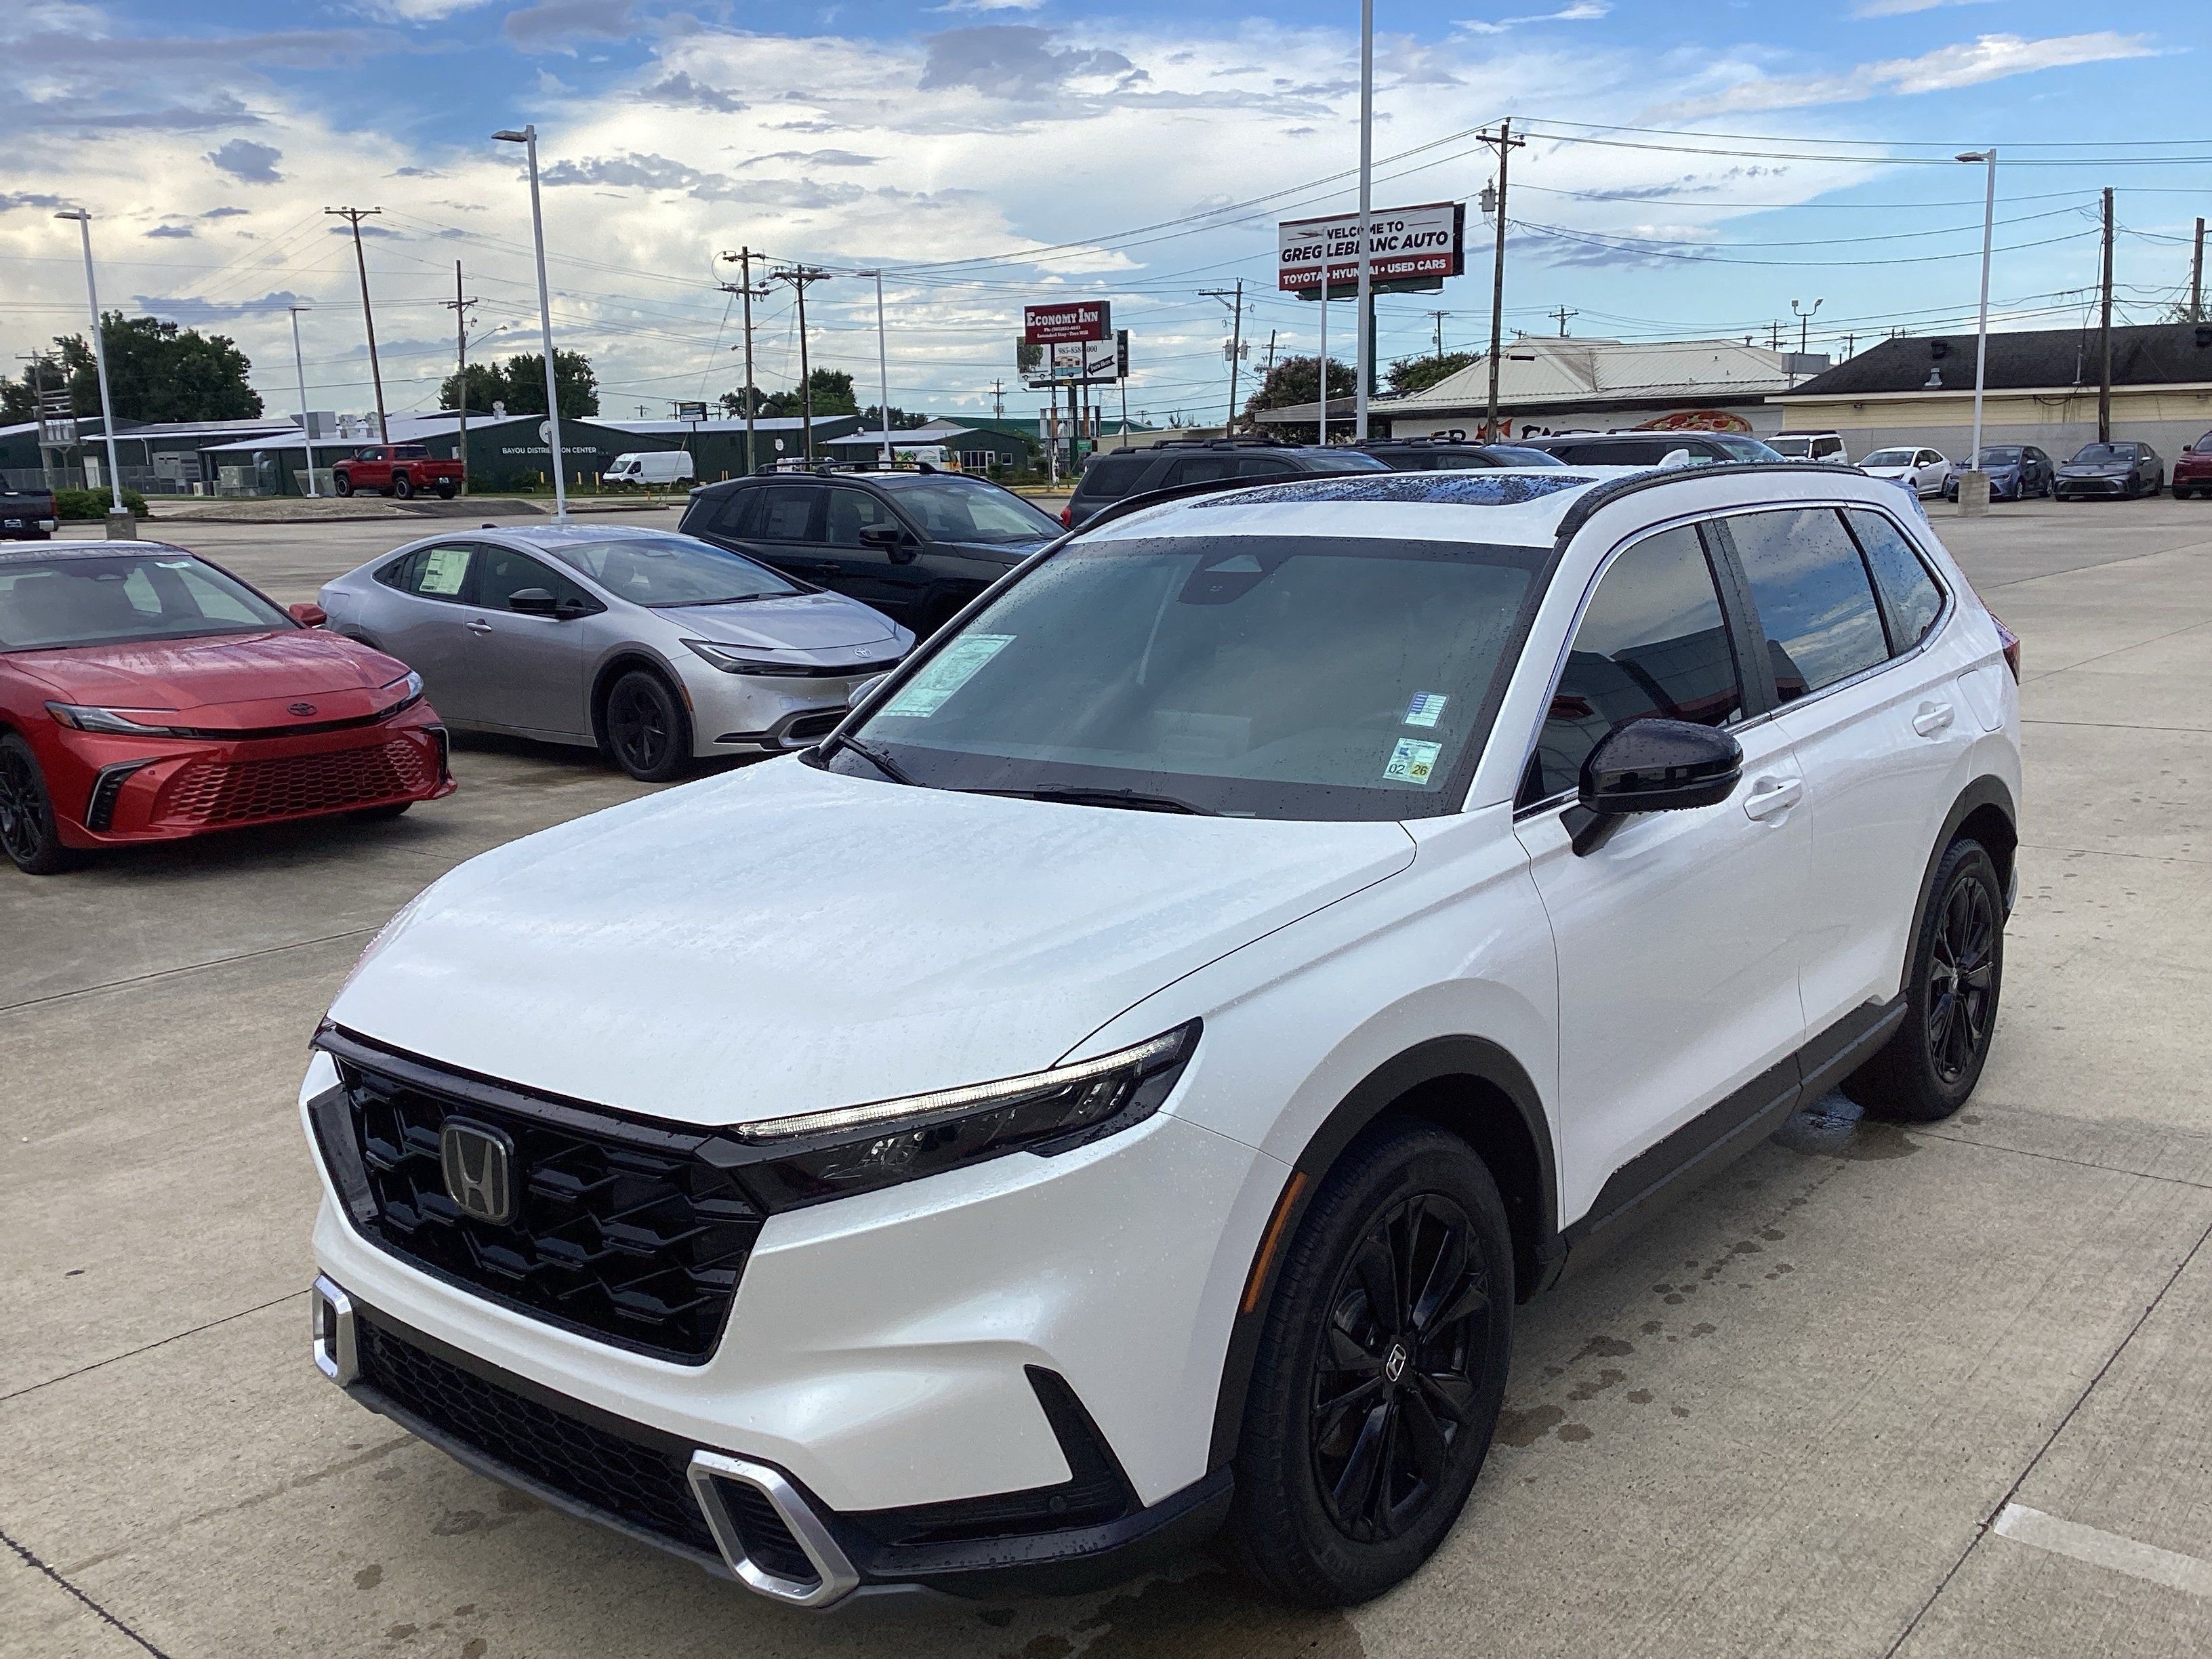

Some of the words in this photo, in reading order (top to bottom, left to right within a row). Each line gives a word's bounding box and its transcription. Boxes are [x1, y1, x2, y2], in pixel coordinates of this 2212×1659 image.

[1387, 220, 1404, 232] TO
[1282, 245, 1323, 262] GREG
[1401, 230, 1448, 249] AUTO
[1283, 271, 1322, 285] TOYOTA
[1332, 265, 1378, 279] HYUNAI
[1387, 262, 1415, 273] USED
[1417, 259, 1446, 270] CARS
[1389, 764, 1406, 775] 02
[1412, 764, 1429, 776] 26
